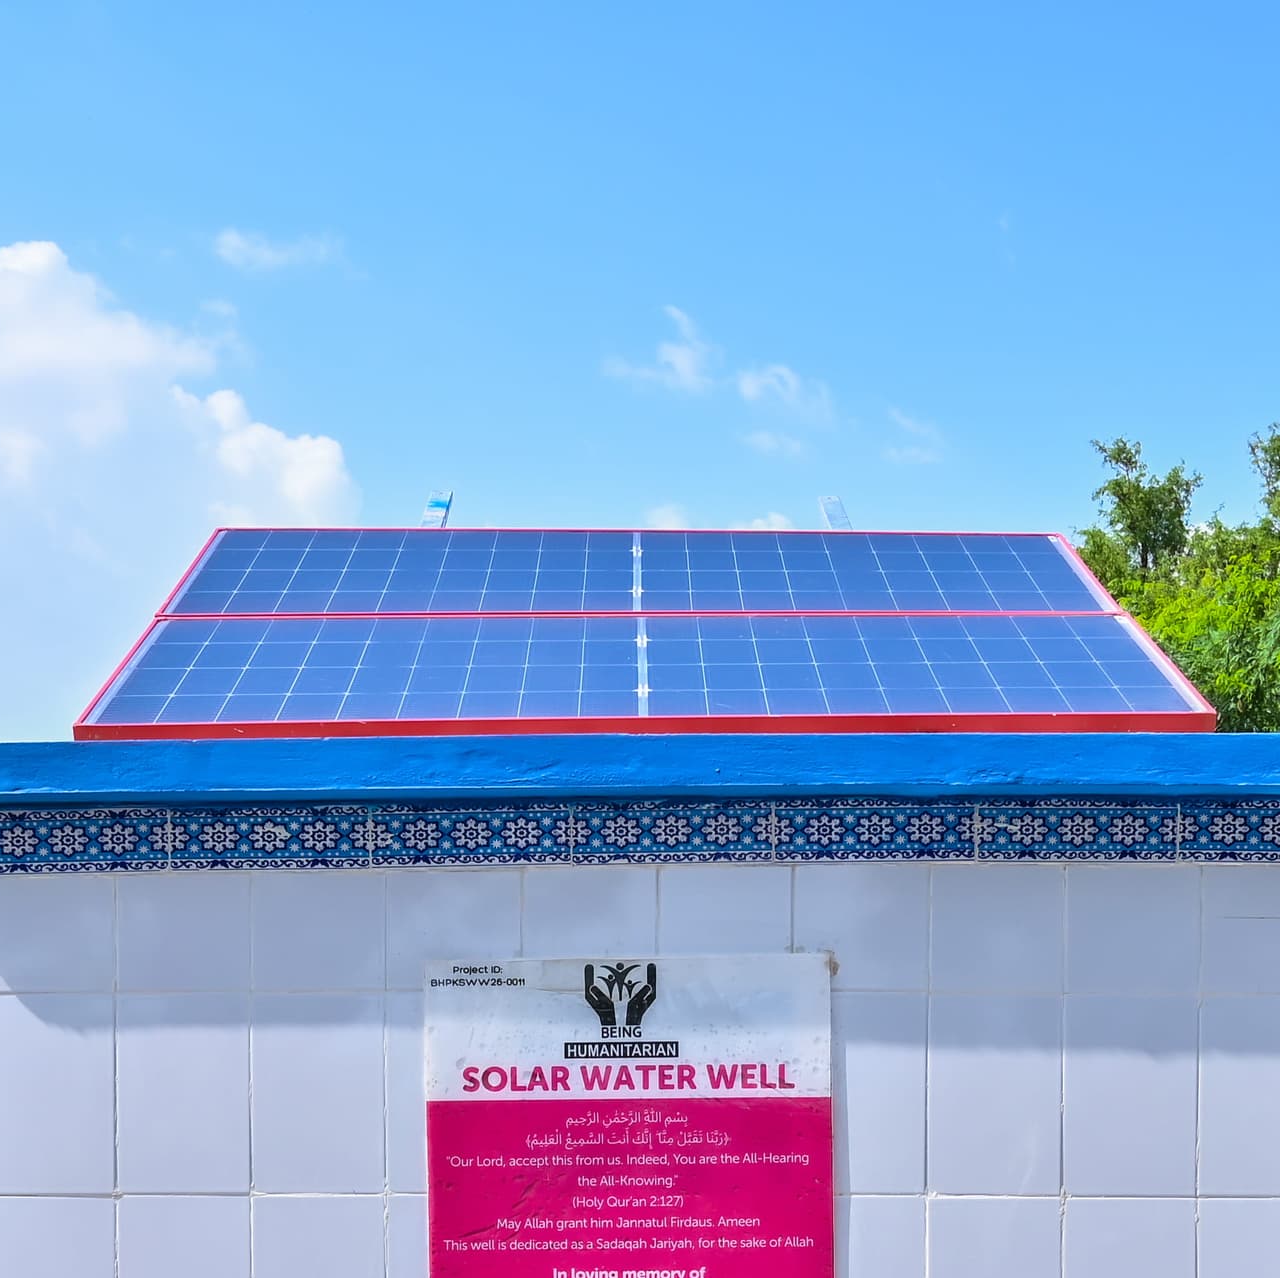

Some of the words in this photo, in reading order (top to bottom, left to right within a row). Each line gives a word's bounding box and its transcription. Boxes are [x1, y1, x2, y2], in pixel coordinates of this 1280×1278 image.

[453, 966, 488, 975] Project
[491, 965, 503, 974] ID:
[431, 978, 525, 987] BHPKSWW26-0011
[601, 1026, 642, 1039] BEING
[568, 1043, 676, 1057] HUMANITARIAN
[463, 1066, 571, 1092] SOLAR
[580, 1064, 697, 1091] WATER
[706, 1064, 795, 1089] WELL
[477, 1155, 506, 1168] Lord,
[509, 1156, 549, 1168] accept
[552, 1155, 573, 1166] this
[575, 1154, 604, 1165] from
[607, 1156, 623, 1165] us.
[627, 1154, 670, 1166] Indeed,
[673, 1153, 696, 1165] You
[699, 1155, 717, 1164] are
[720, 1153, 740, 1164] the
[742, 1152, 809, 1166] All-Hearing
[578, 1176, 597, 1186] the
[572, 1196, 604, 1210] (Holy
[650, 1195, 684, 1207] 2:127)
[497, 1218, 522, 1232] May
[524, 1217, 553, 1229] Allah
[556, 1218, 588, 1231] grant
[590, 1217, 613, 1228] him
[616, 1217, 667, 1228] Jannatul
[671, 1216, 715, 1228] Firdaus.
[717, 1216, 760, 1227] Ameen
[443, 1240, 468, 1251] This
[470, 1239, 495, 1250] well
[498, 1239, 507, 1250] is
[509, 1239, 568, 1250] dedicated
[570, 1241, 584, 1250] as
[586, 1241, 593, 1249] a
[596, 1238, 647, 1251] Sadaqah
[650, 1237, 695, 1251] Jariyah,
[698, 1237, 715, 1248] for
[718, 1237, 737, 1248] the
[740, 1237, 766, 1248] sake
[769, 1237, 782, 1247] of
[784, 1236, 814, 1247] Allah
